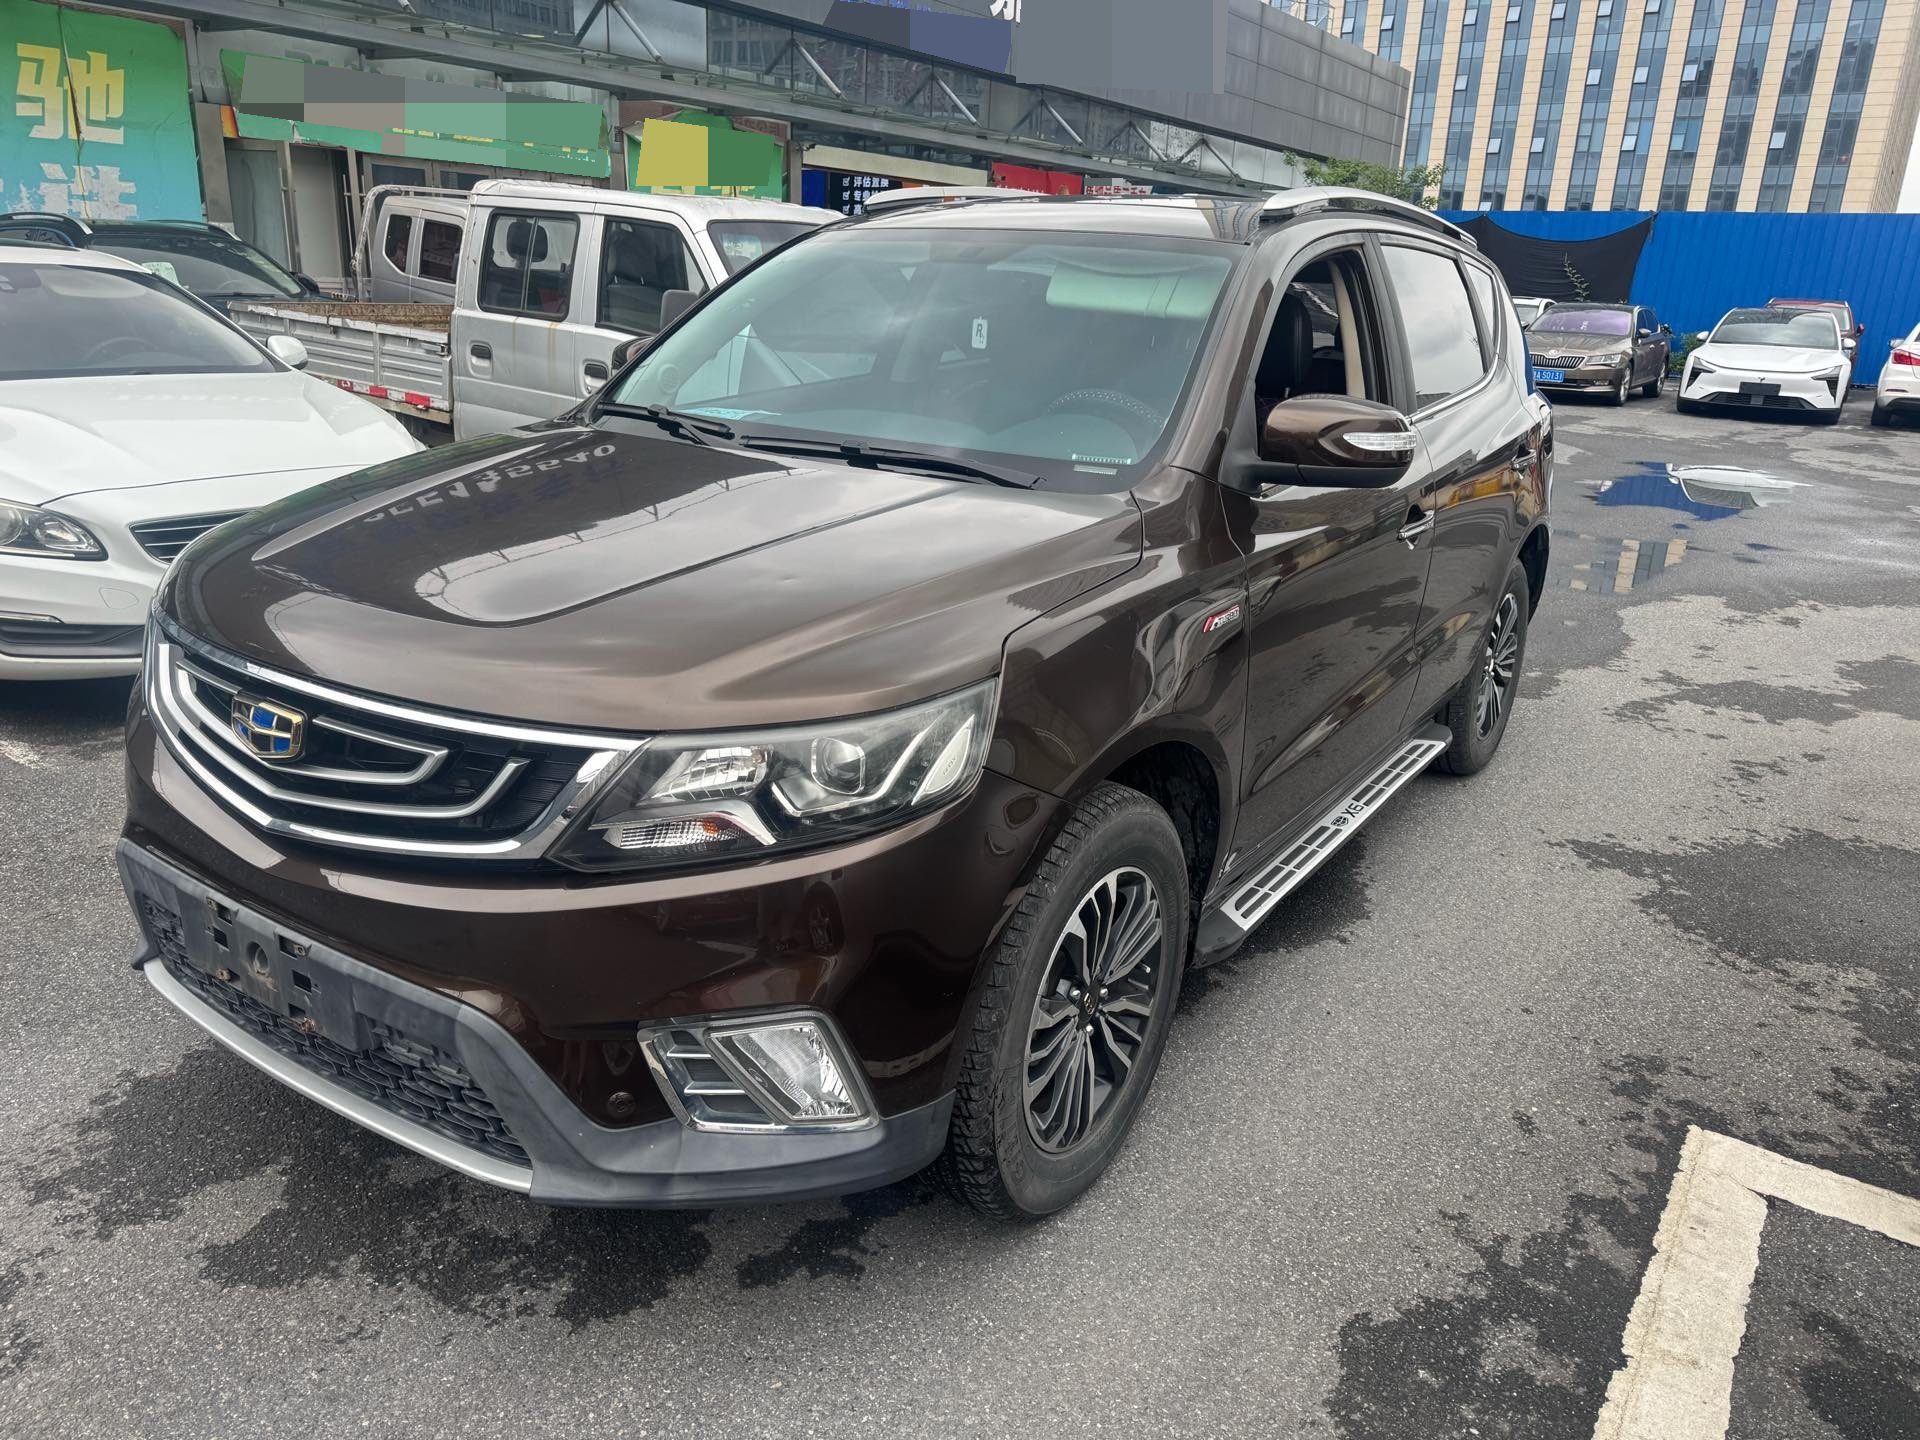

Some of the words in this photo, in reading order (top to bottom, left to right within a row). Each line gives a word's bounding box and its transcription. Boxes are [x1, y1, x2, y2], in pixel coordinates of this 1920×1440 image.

[16, 43, 124, 144] 驰
[853, 176, 889, 188] 评估置换
[1341, 802, 1365, 818] X6
